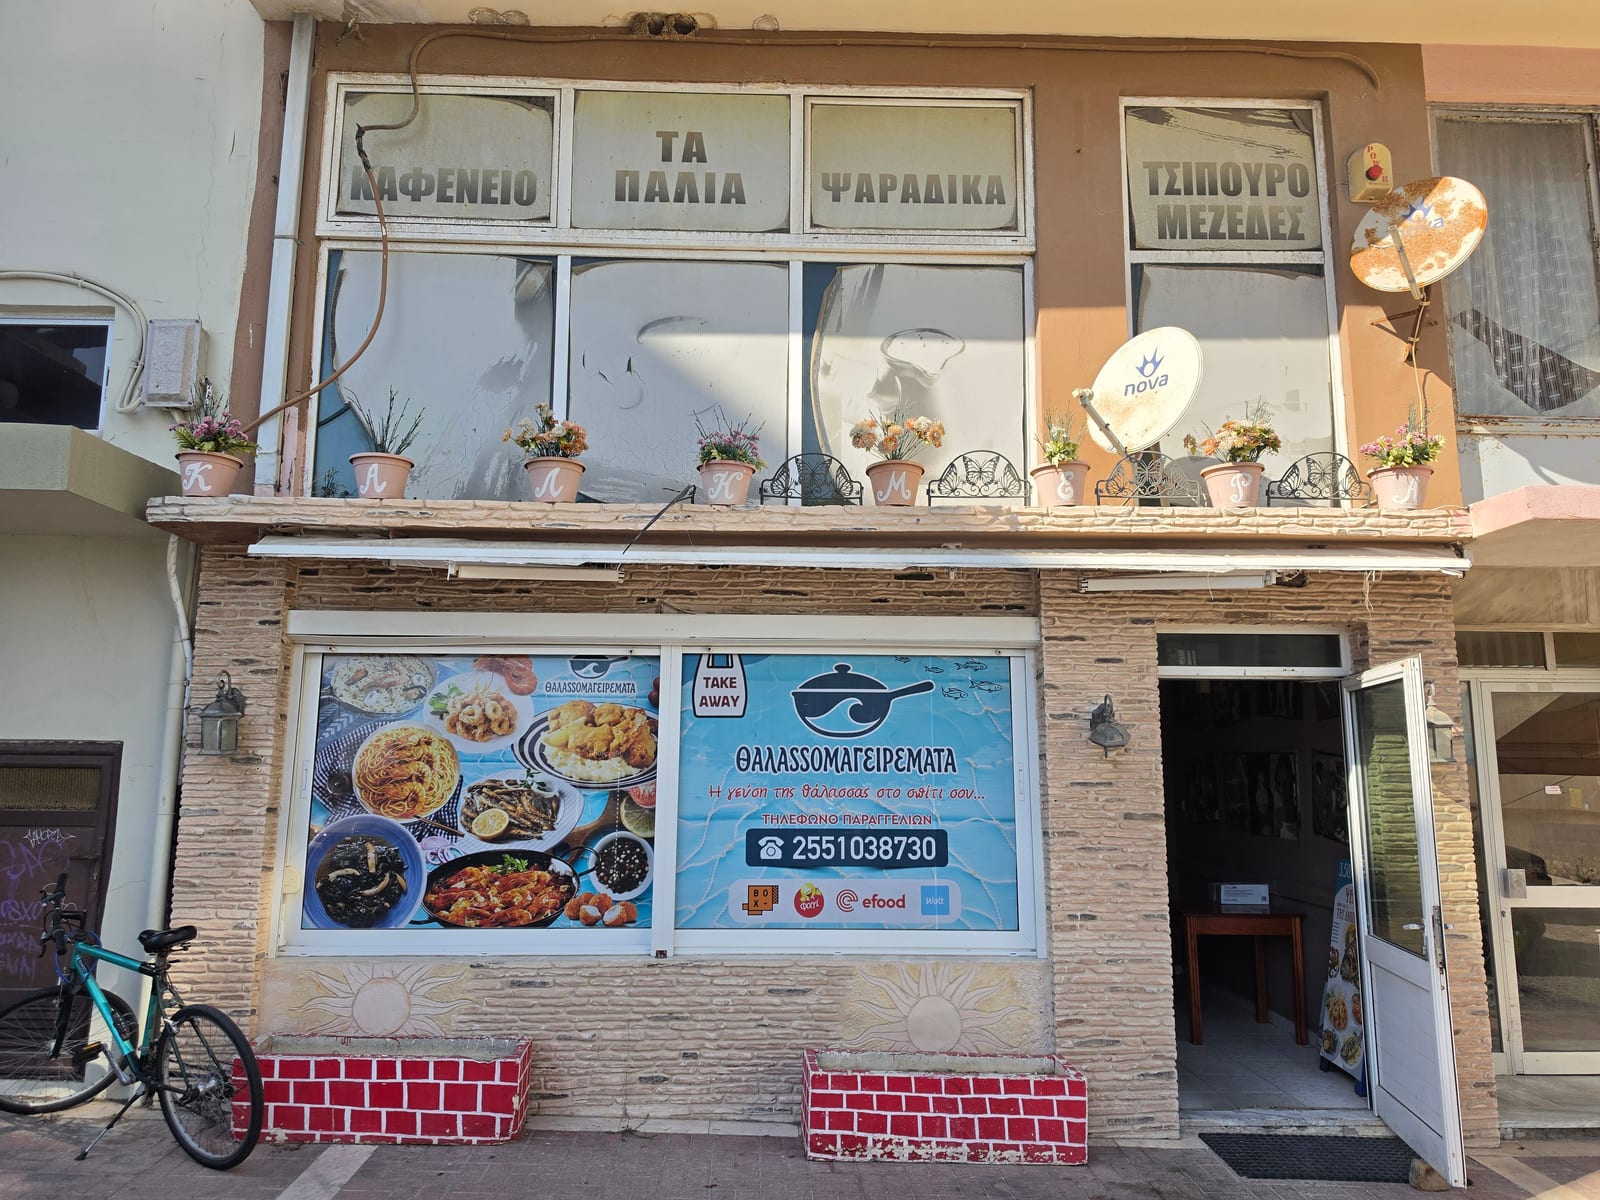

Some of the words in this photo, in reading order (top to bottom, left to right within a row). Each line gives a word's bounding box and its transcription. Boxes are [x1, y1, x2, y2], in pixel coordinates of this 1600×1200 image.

[656, 131, 708, 163] ΤΑ
[350, 166, 538, 206] ΚΑΦΕΝΕΙΟ
[615, 170, 747, 205] ΠΑΛΙΑ
[821, 172, 1007, 205] ΨΑΡΑΔΙΚΑ
[1143, 161, 1311, 198] ΤΣΙΠΟΥΡΟ
[1157, 204, 1306, 240] ΜΕΖΕΔΕΣ
[1124, 372, 1169, 397] nova
[703, 677, 737, 689] TAKE
[699, 695, 740, 708] AWAY
[709, 785, 721, 797] Η
[727, 785, 768, 800] γεύση
[774, 787, 795, 798] της
[802, 784, 870, 798] θάλασσας
[877, 788, 901, 798] στο
[907, 785, 943, 798] σπίτι
[762, 814, 838, 824] ΤΗΛΕΦΩΝΟ
[843, 814, 932, 825] ΠΑΡΑΓΓΕΛΙΩΝ
[792, 835, 936, 860] 2551038730
[862, 894, 906, 909] efood
[926, 897, 945, 905] Wolt
